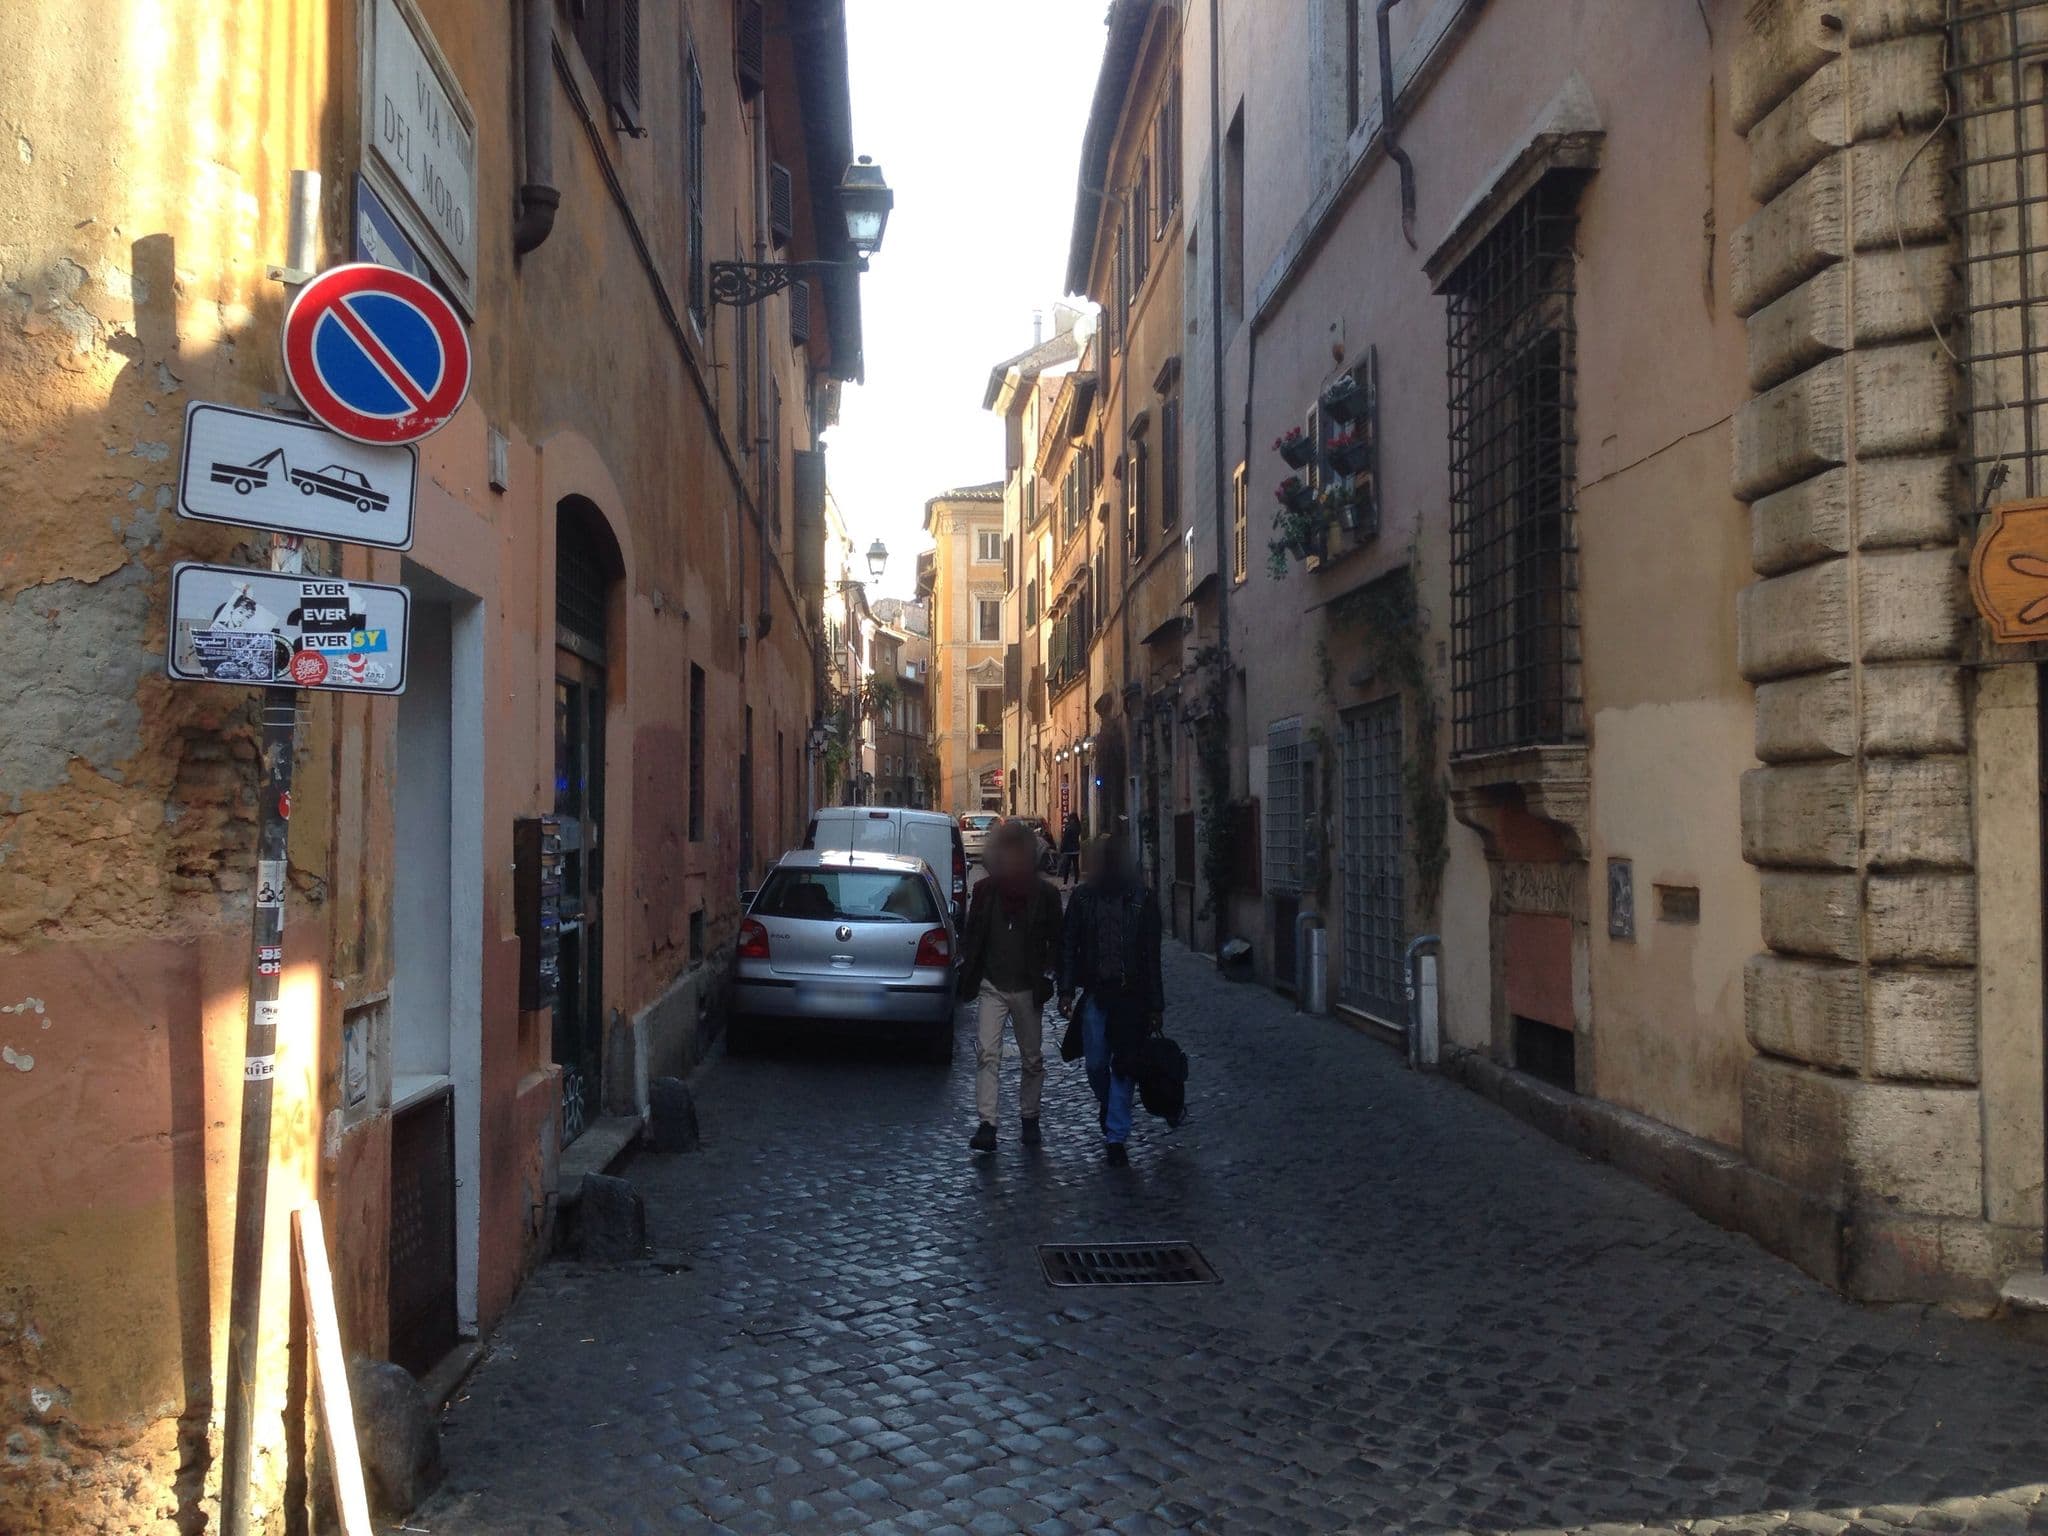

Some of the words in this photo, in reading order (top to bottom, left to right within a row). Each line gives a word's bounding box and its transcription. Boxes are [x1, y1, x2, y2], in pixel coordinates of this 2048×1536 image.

[416, 71, 441, 149] VIA
[384, 95, 414, 174] DEL
[422, 152, 465, 246] MORO
[302, 584, 345, 596] EVER
[303, 608, 347, 621] EVER
[305, 635, 348, 648] EVER
